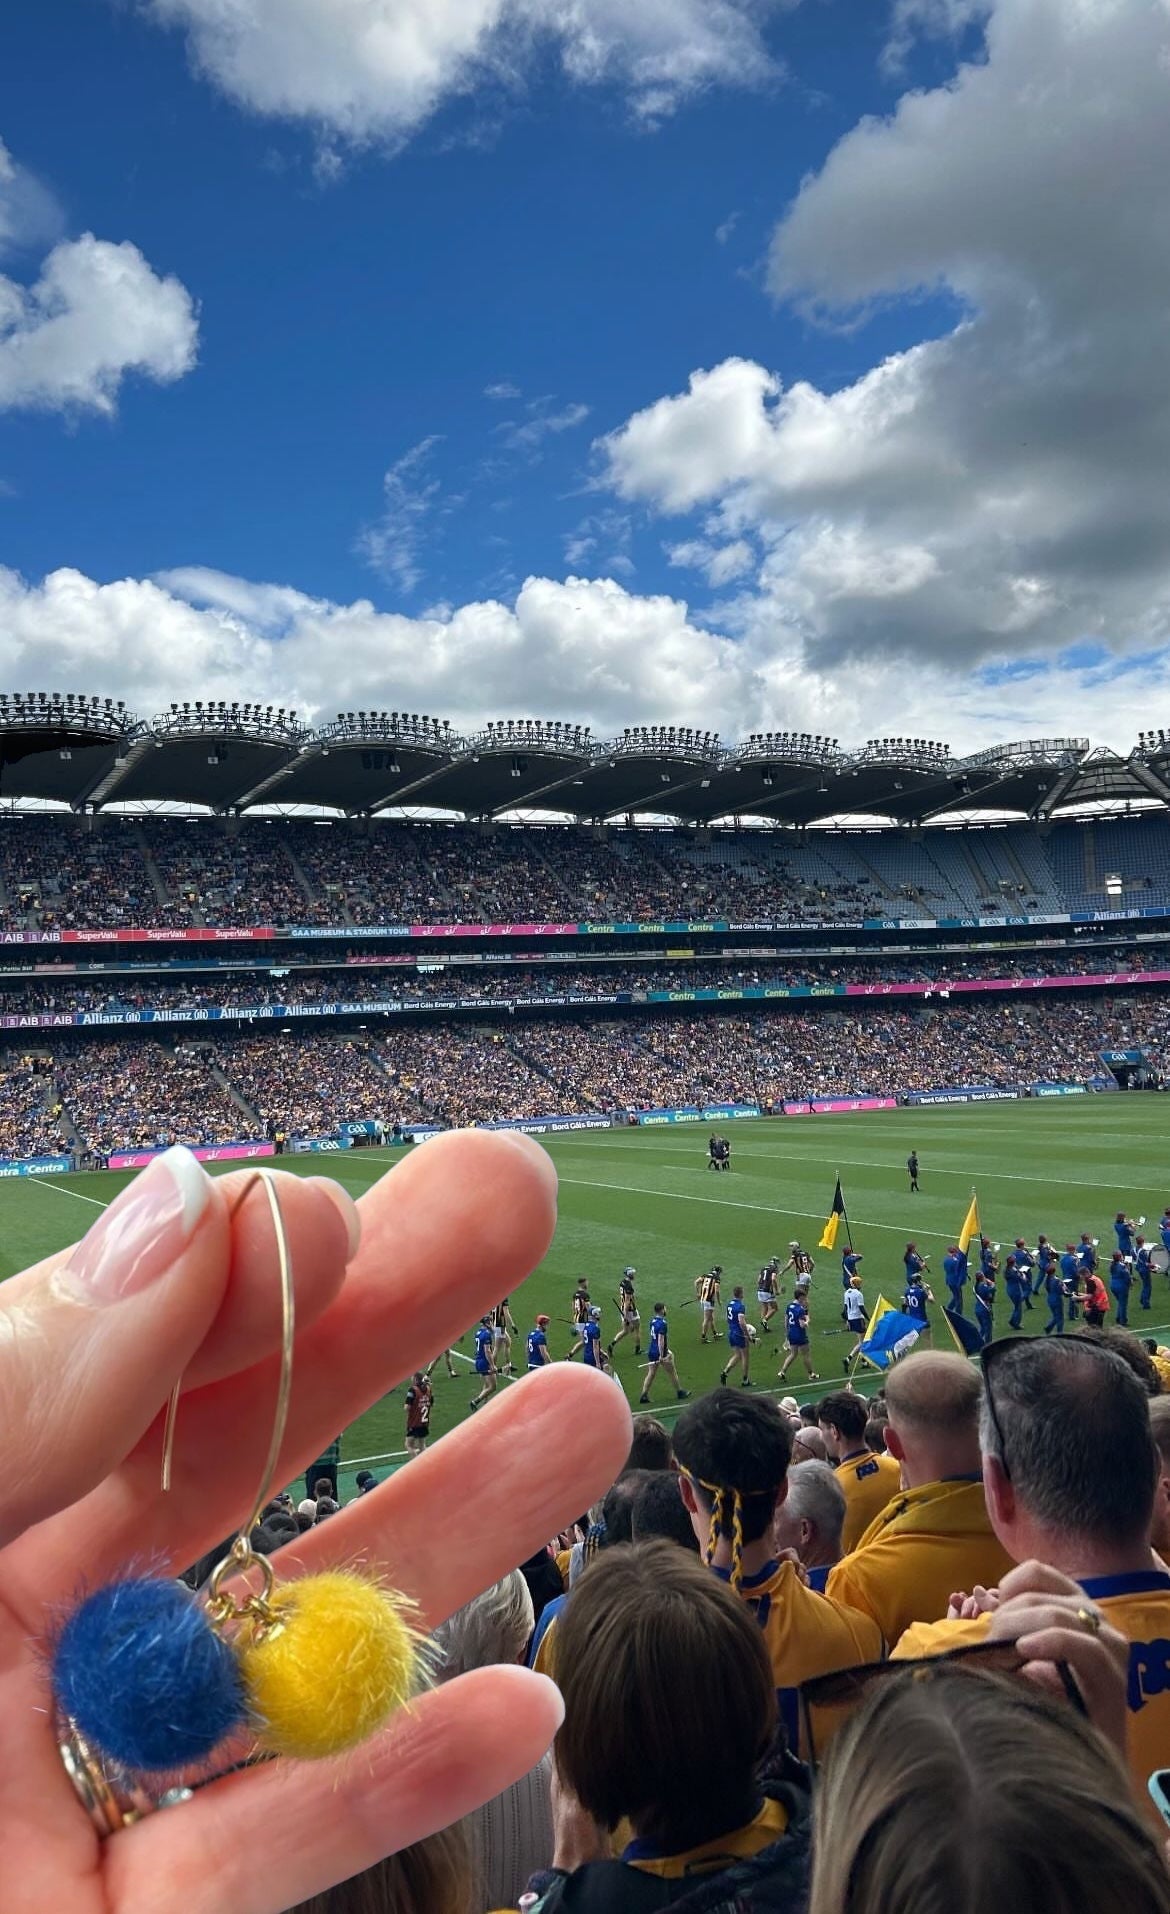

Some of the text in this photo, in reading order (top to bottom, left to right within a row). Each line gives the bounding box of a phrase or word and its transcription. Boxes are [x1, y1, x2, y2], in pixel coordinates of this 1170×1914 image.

[1094, 911, 1126, 920] Allianz
[587, 924, 614, 933] Centra
[639, 923, 664, 932] Centra
[688, 922, 713, 931] Centra
[755, 922, 773, 930] Energy
[5, 933, 24, 942] AIB
[41, 932, 60, 941] AIB
[77, 932, 118, 940] SuperValu
[147, 930, 187, 939] SuperValu
[215, 930, 253, 938] SuperValu
[718, 990, 743, 999] Centra
[765, 989, 789, 997] Centra
[811, 987, 834, 995] Centra
[669, 992, 695, 1000] Centra
[285, 1005, 321, 1016] Allianz
[366, 1003, 400, 1011] MUSEUM
[153, 1011, 192, 1021] Allianz
[220, 1008, 257, 1018] Allianz
[20, 1017, 38, 1026] AIB
[54, 1016, 72, 1024] AIB
[83, 1013, 123, 1023] Allianz
[674, 1113, 699, 1122] Centra
[704, 1111, 729, 1119] Centra
[734, 1109, 757, 1117] Centra
[552, 1122, 569, 1130] Bord
[587, 1119, 610, 1128] Energy
[644, 1116, 669, 1125] Centra
[347, 1124, 367, 1133] GAA
[320, 1141, 340, 1150] GAA
[28, 1163, 64, 1174] Centra
[907, 1295, 919, 1308] 10
[727, 1306, 733, 1320] 3
[789, 1312, 796, 1325] 2
[421, 1406, 429, 1422] 2
